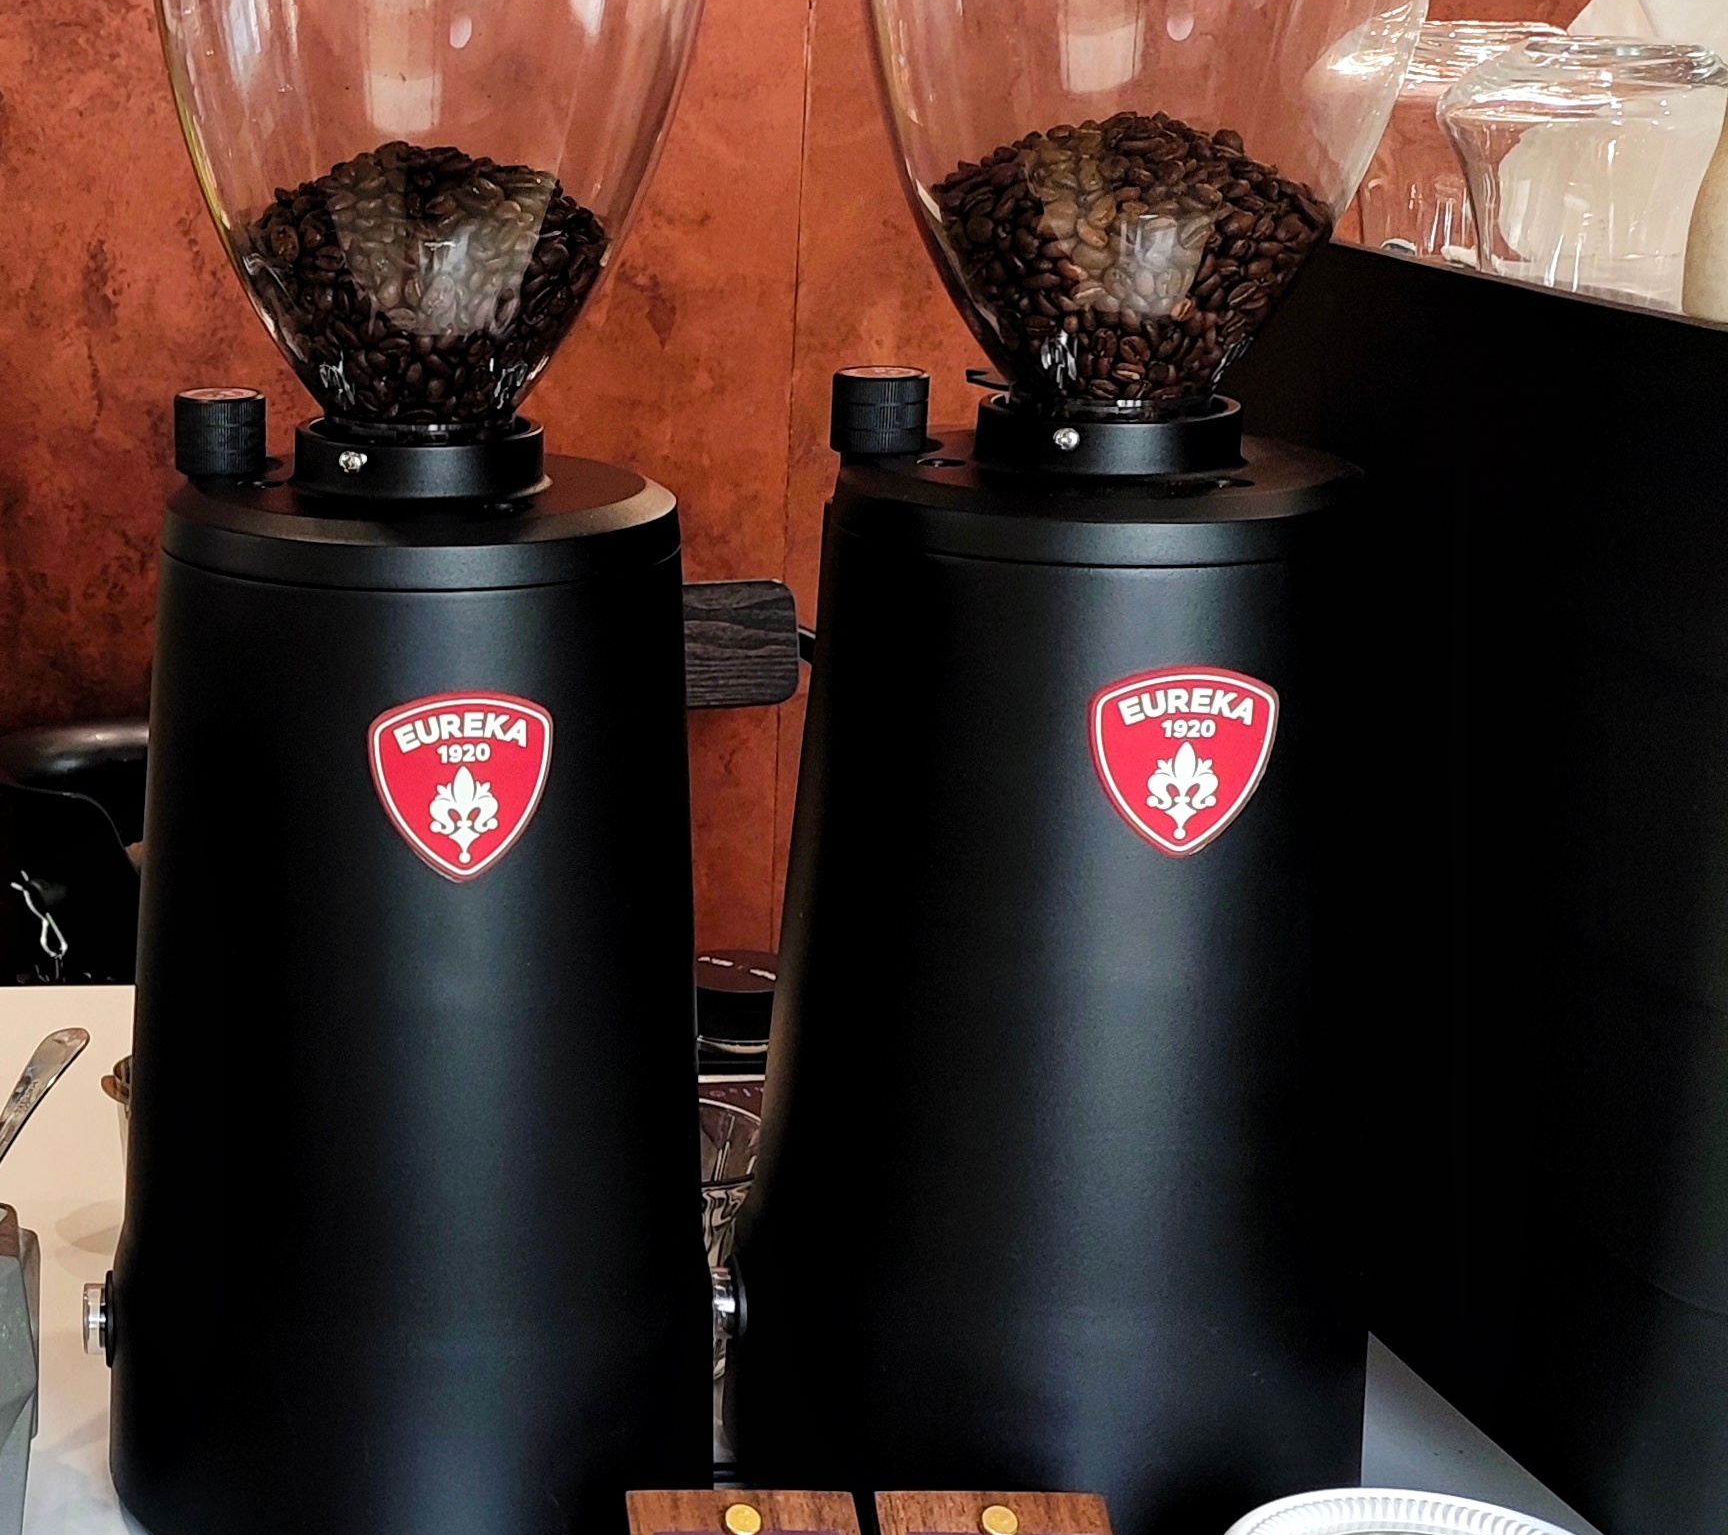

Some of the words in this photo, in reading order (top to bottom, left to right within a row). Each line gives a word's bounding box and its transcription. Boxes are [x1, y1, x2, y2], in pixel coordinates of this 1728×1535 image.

[1117, 687, 1255, 726] EUREKA
[392, 711, 529, 754] EUREKA
[1160, 719, 1216, 739] 1920
[436, 742, 491, 764] 1920
